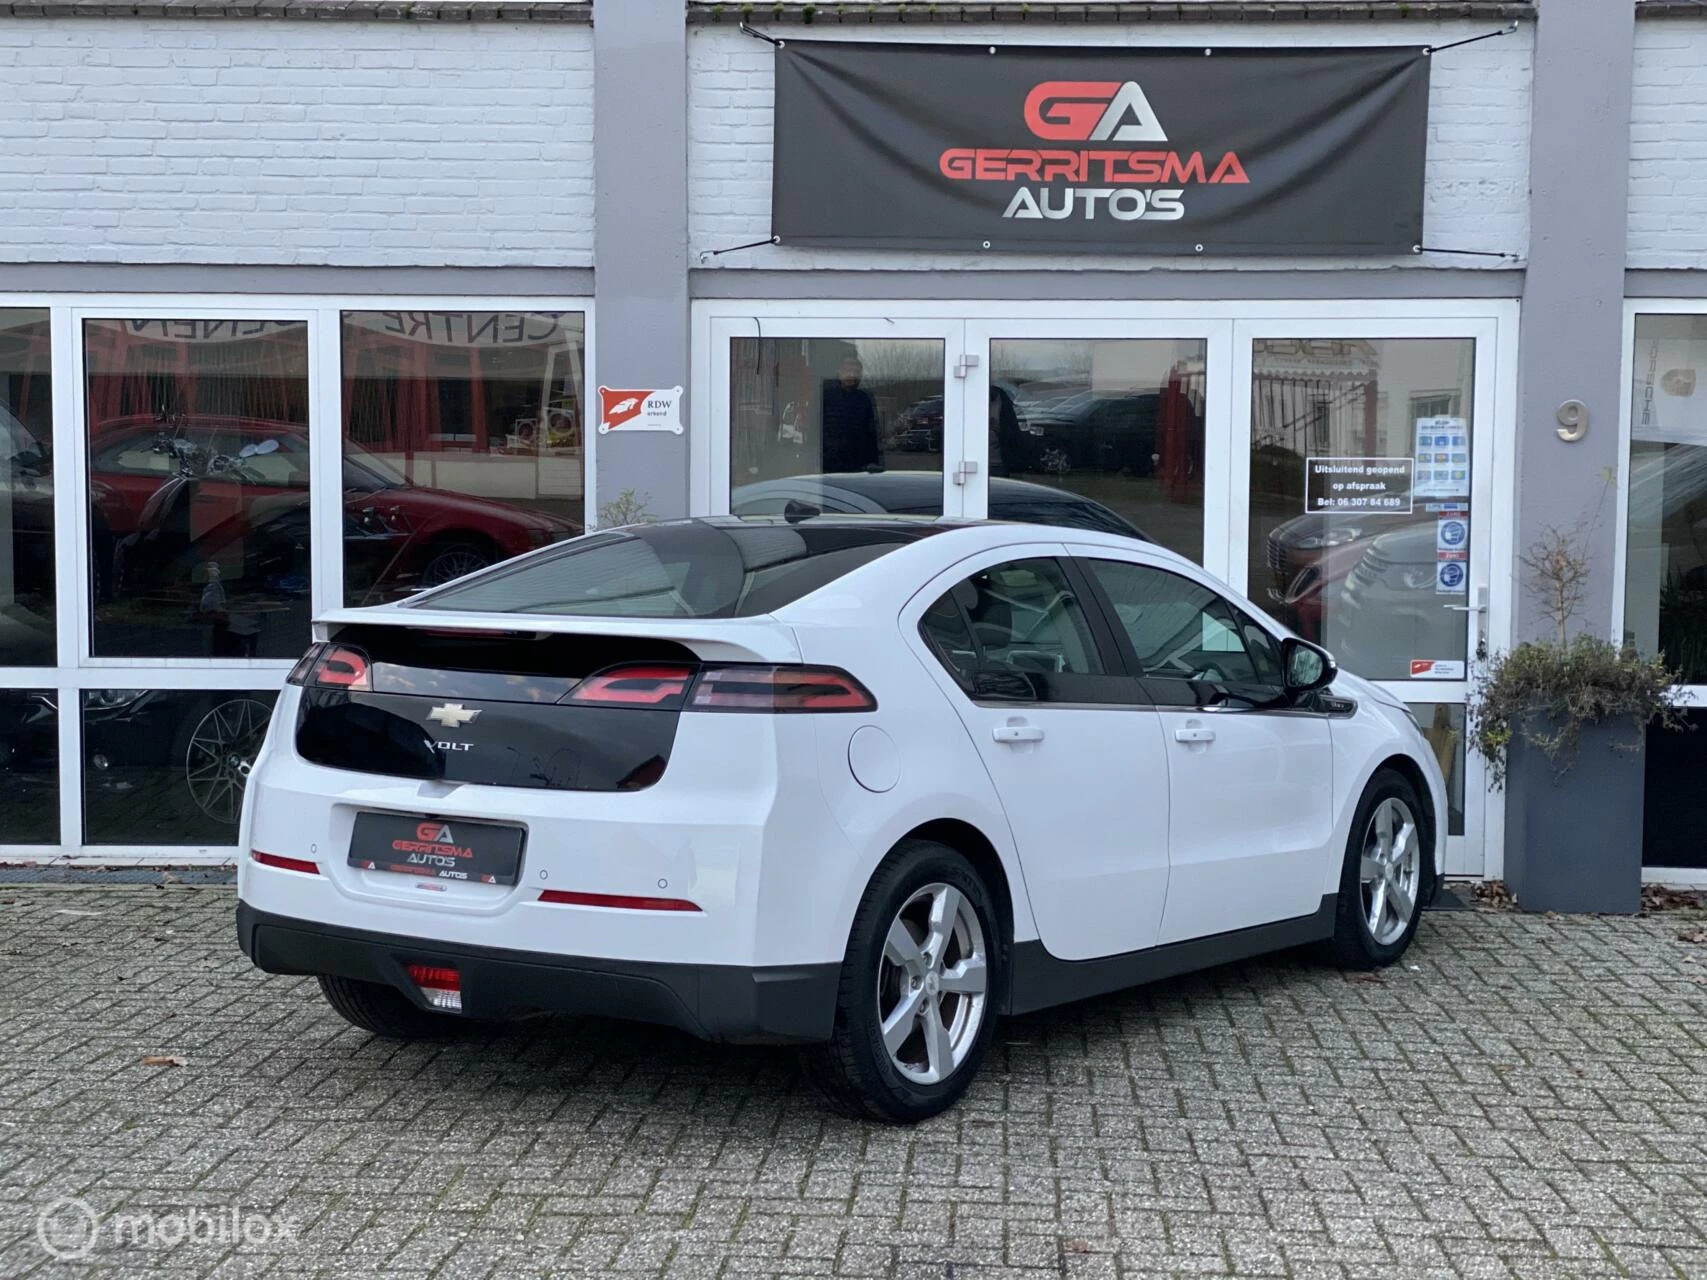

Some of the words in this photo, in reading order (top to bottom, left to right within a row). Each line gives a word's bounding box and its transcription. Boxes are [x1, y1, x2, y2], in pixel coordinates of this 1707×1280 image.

[1023, 79, 1168, 142] GA
[939, 148, 1251, 184] GERRITSMA
[1002, 186, 1185, 221] AUTO'S
[647, 400, 672, 409] RDW
[1556, 399, 1588, 443] 9
[1315, 465, 1364, 474] Uitsluitend
[1366, 466, 1405, 476] geopend
[1332, 483, 1344, 491] op
[1346, 481, 1386, 491] afspraak
[1317, 498, 1335, 506] Bel:
[1337, 498, 1350, 506] 06
[1352, 498, 1367, 506] 307
[1370, 498, 1381, 506] 84
[1383, 498, 1401, 506] 689
[424, 740, 475, 752] VOLT
[416, 822, 454, 844] GA
[392, 839, 473, 859] GERRITSMA
[407, 852, 456, 868] AUTO'S
